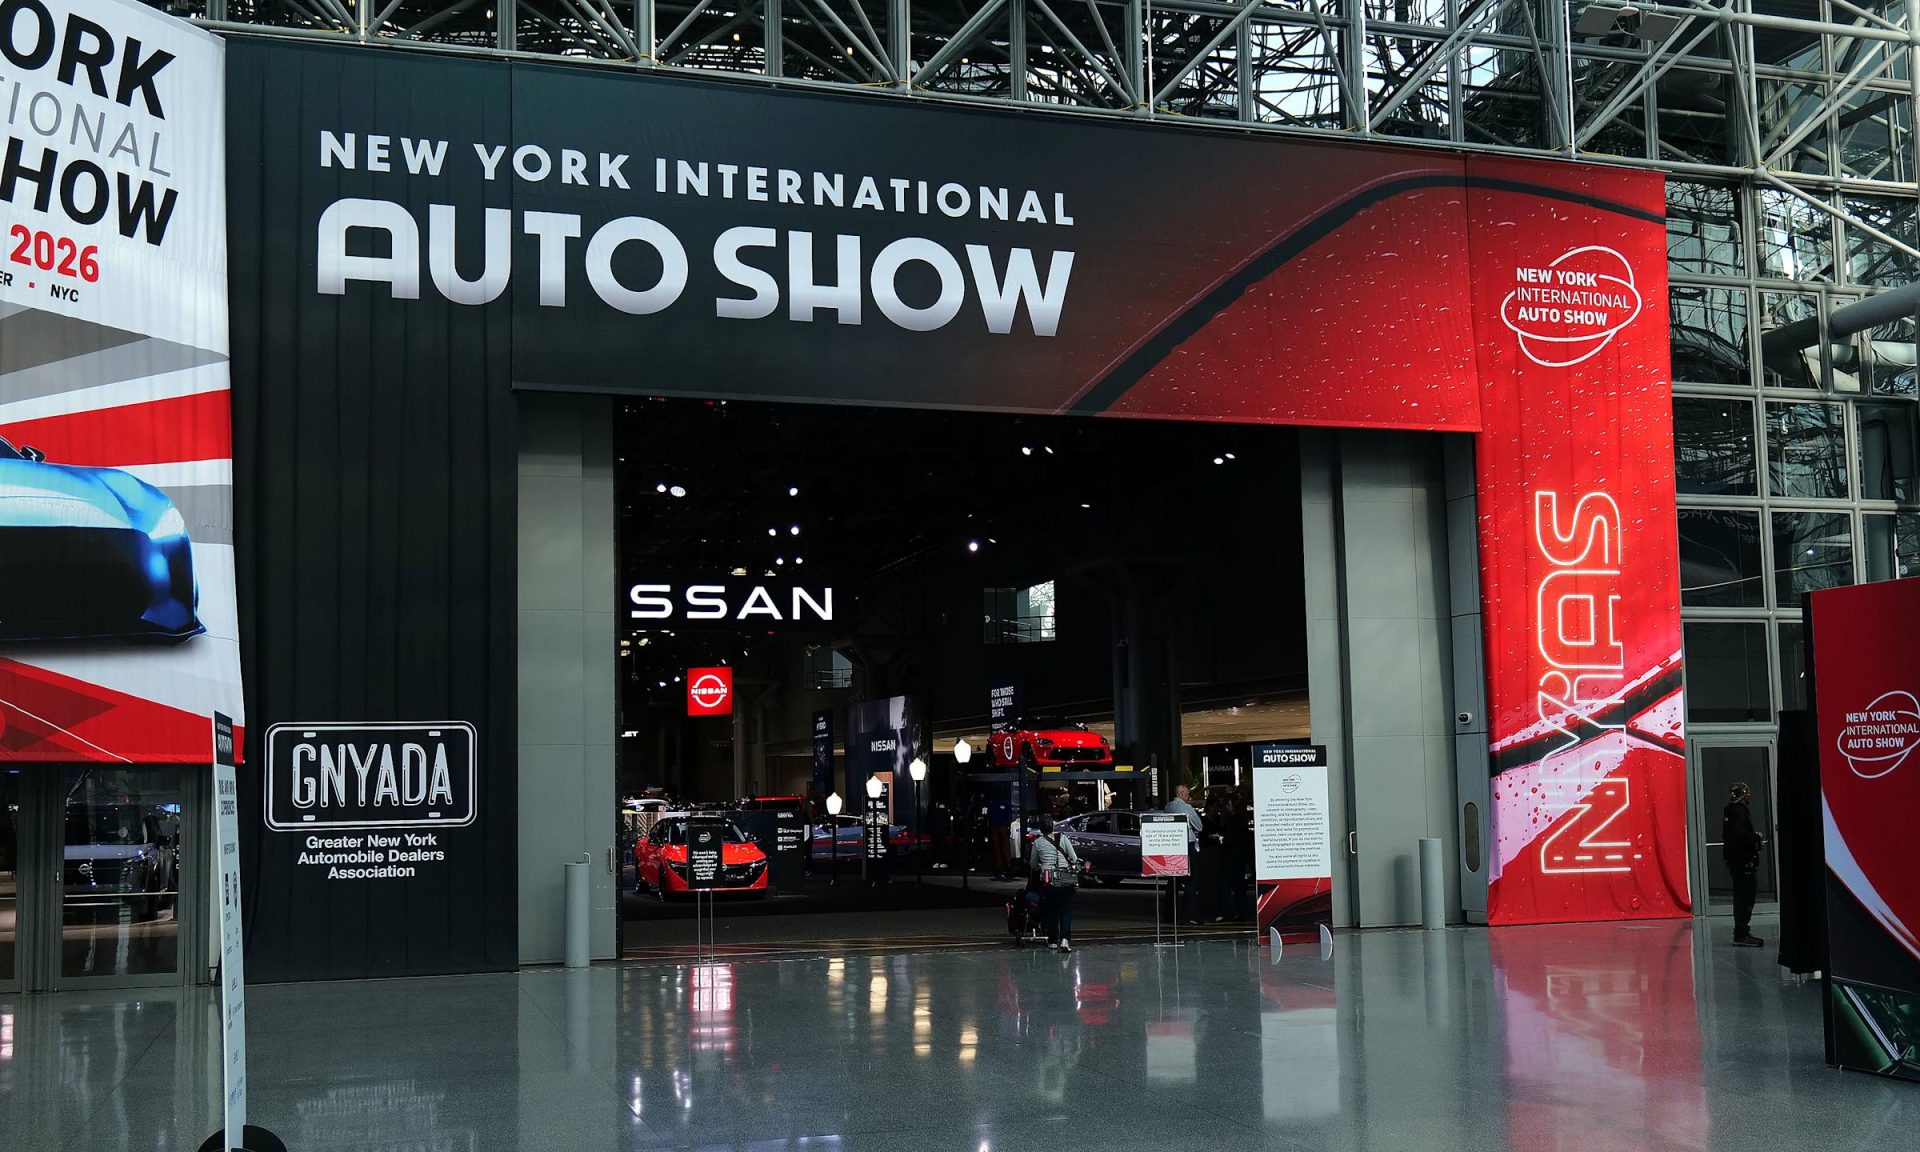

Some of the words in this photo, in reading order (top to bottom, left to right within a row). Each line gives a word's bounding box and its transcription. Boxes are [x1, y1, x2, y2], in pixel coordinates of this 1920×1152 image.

[0, 0, 177, 120] ORK
[0, 76, 171, 177] IONAL
[320, 130, 449, 176] NEW
[473, 143, 631, 190] YORK
[656, 157, 1074, 226] INTERNATIONAL
[0, 136, 179, 247] HOW
[10, 223, 99, 283] 2026
[317, 197, 689, 315] AUTO
[713, 225, 1075, 337] SHOW
[1516, 267, 1552, 284] NEW
[1556, 270, 1598, 287] YORK
[50, 284, 79, 303] NYC
[1517, 286, 1632, 309] INTERNATIONAL
[1518, 306, 1560, 322] AUTO
[1564, 309, 1608, 326] SHOW
[1846, 712, 1868, 723] NEW
[1870, 710, 1896, 721] YORK
[1846, 723, 1920, 736] INTERNATIONAL
[871, 740, 896, 752] NISSAN
[1848, 738, 1873, 749] AUTO
[1876, 737, 1904, 748] SHOW
[1263, 754, 1288, 762] AUTO
[1289, 754, 1316, 762] SHOW
[292, 742, 453, 808] GNYADA
[306, 836, 364, 849] Greater
[368, 834, 401, 848] New
[404, 833, 437, 847] York
[298, 850, 384, 864] Automobile
[388, 849, 444, 862] Dealers
[328, 865, 415, 879] Association
